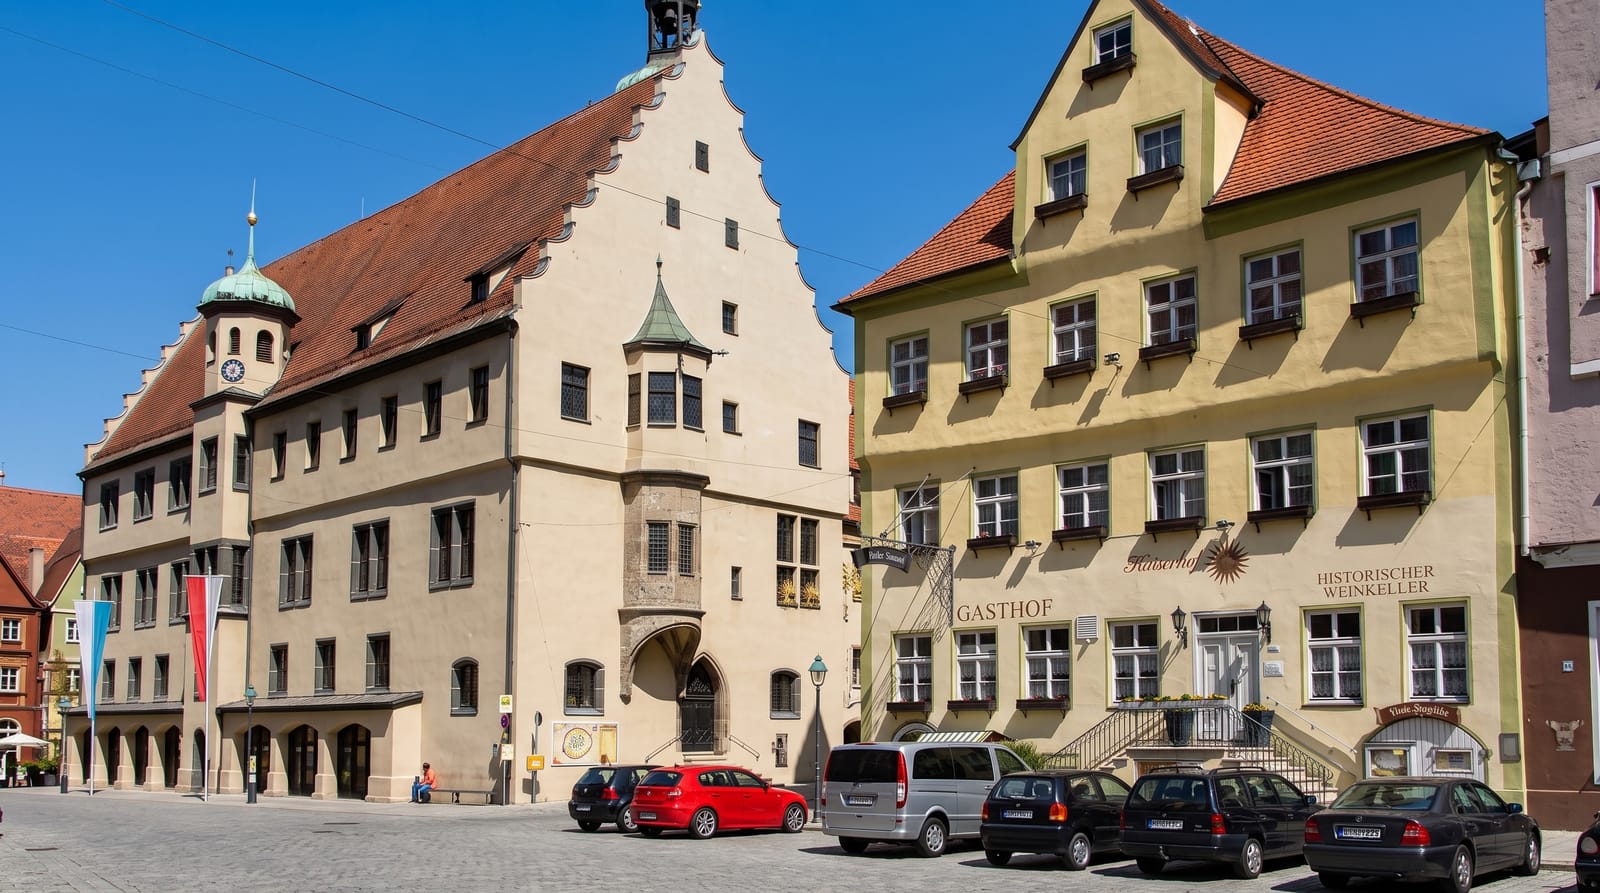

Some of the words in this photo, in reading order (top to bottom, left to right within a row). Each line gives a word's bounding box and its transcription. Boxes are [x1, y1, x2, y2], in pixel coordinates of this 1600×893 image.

[1124, 550, 1204, 575] Kaiserhof
[1318, 565, 1435, 585] HISTORISCHER
[1323, 580, 1430, 599] WEINKELLER
[957, 599, 1053, 622] GASTHOF
